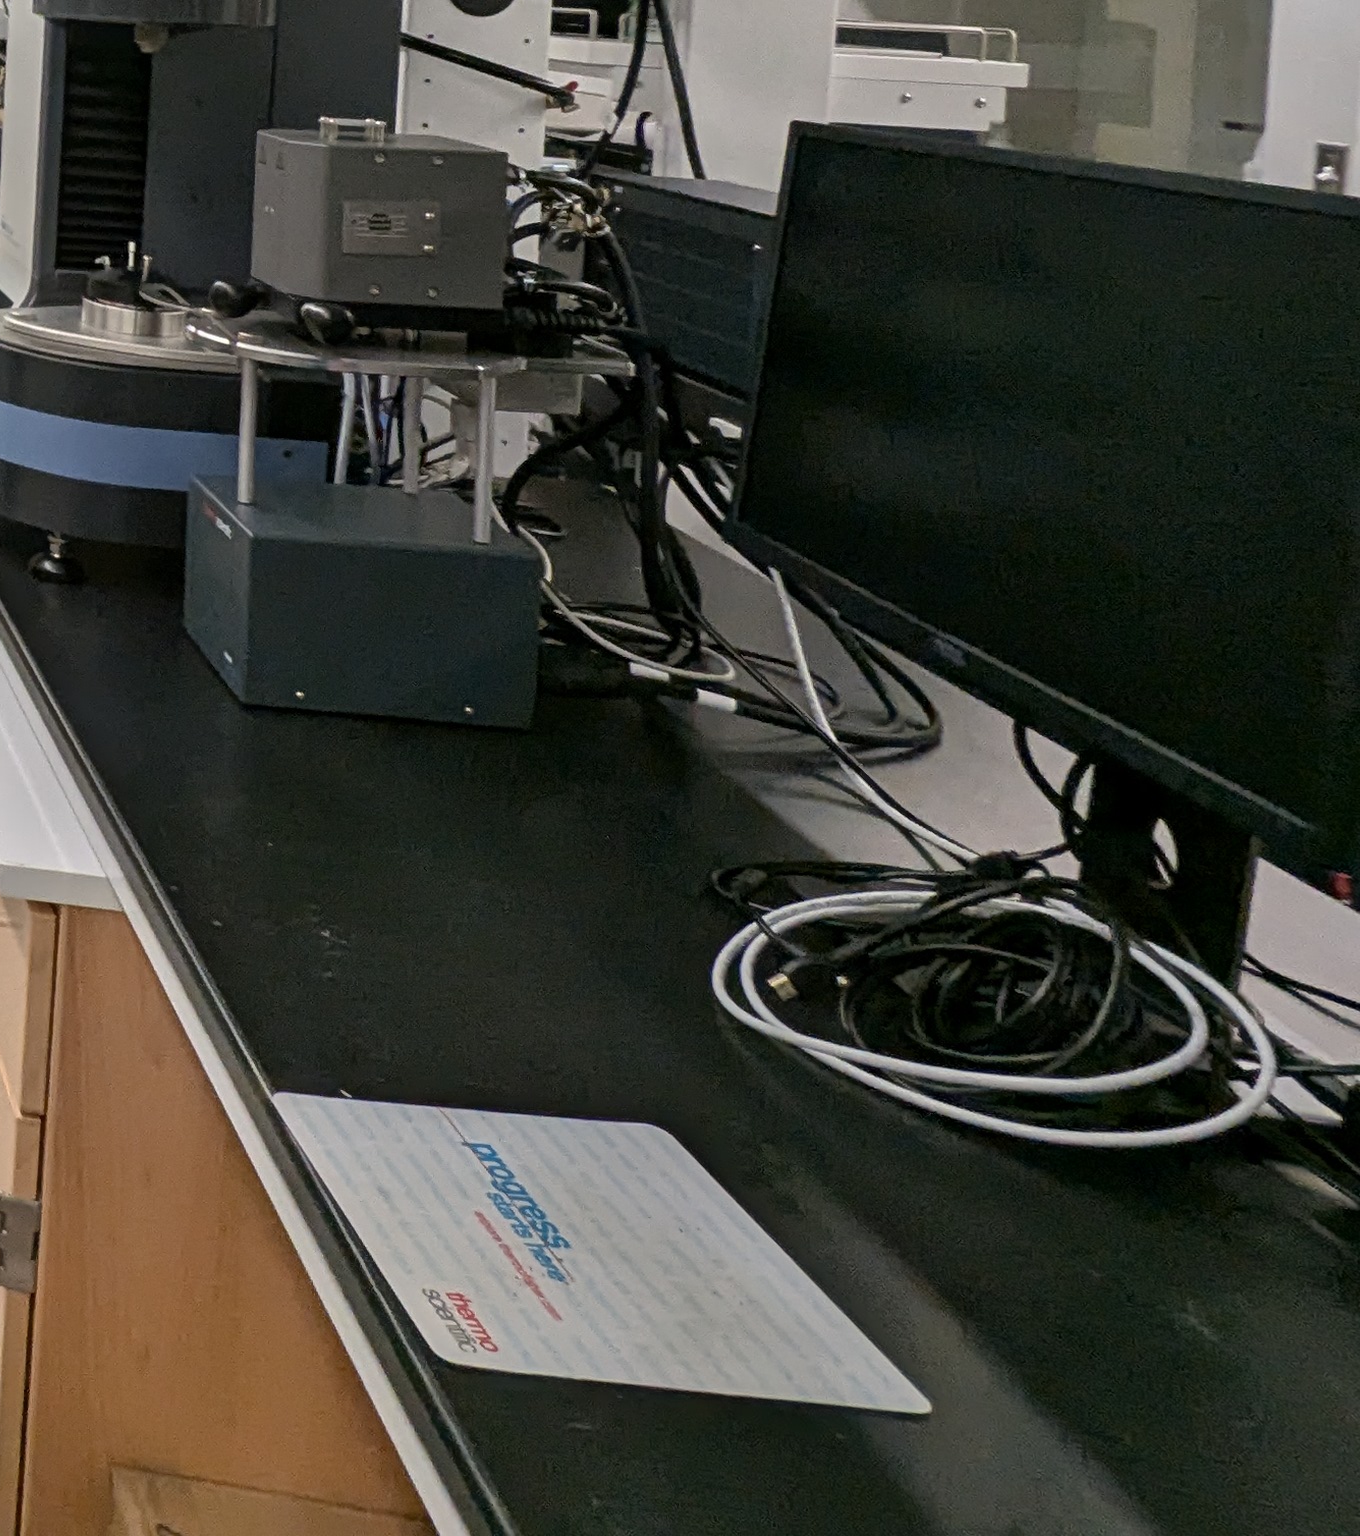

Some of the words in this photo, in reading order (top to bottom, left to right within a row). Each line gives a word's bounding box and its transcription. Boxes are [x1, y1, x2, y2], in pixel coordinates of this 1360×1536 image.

[462, 1142, 571, 1249] progress
[487, 1192, 533, 1238] starts
[422, 1288, 478, 1353] scientific
[445, 1292, 498, 1352] thermo
